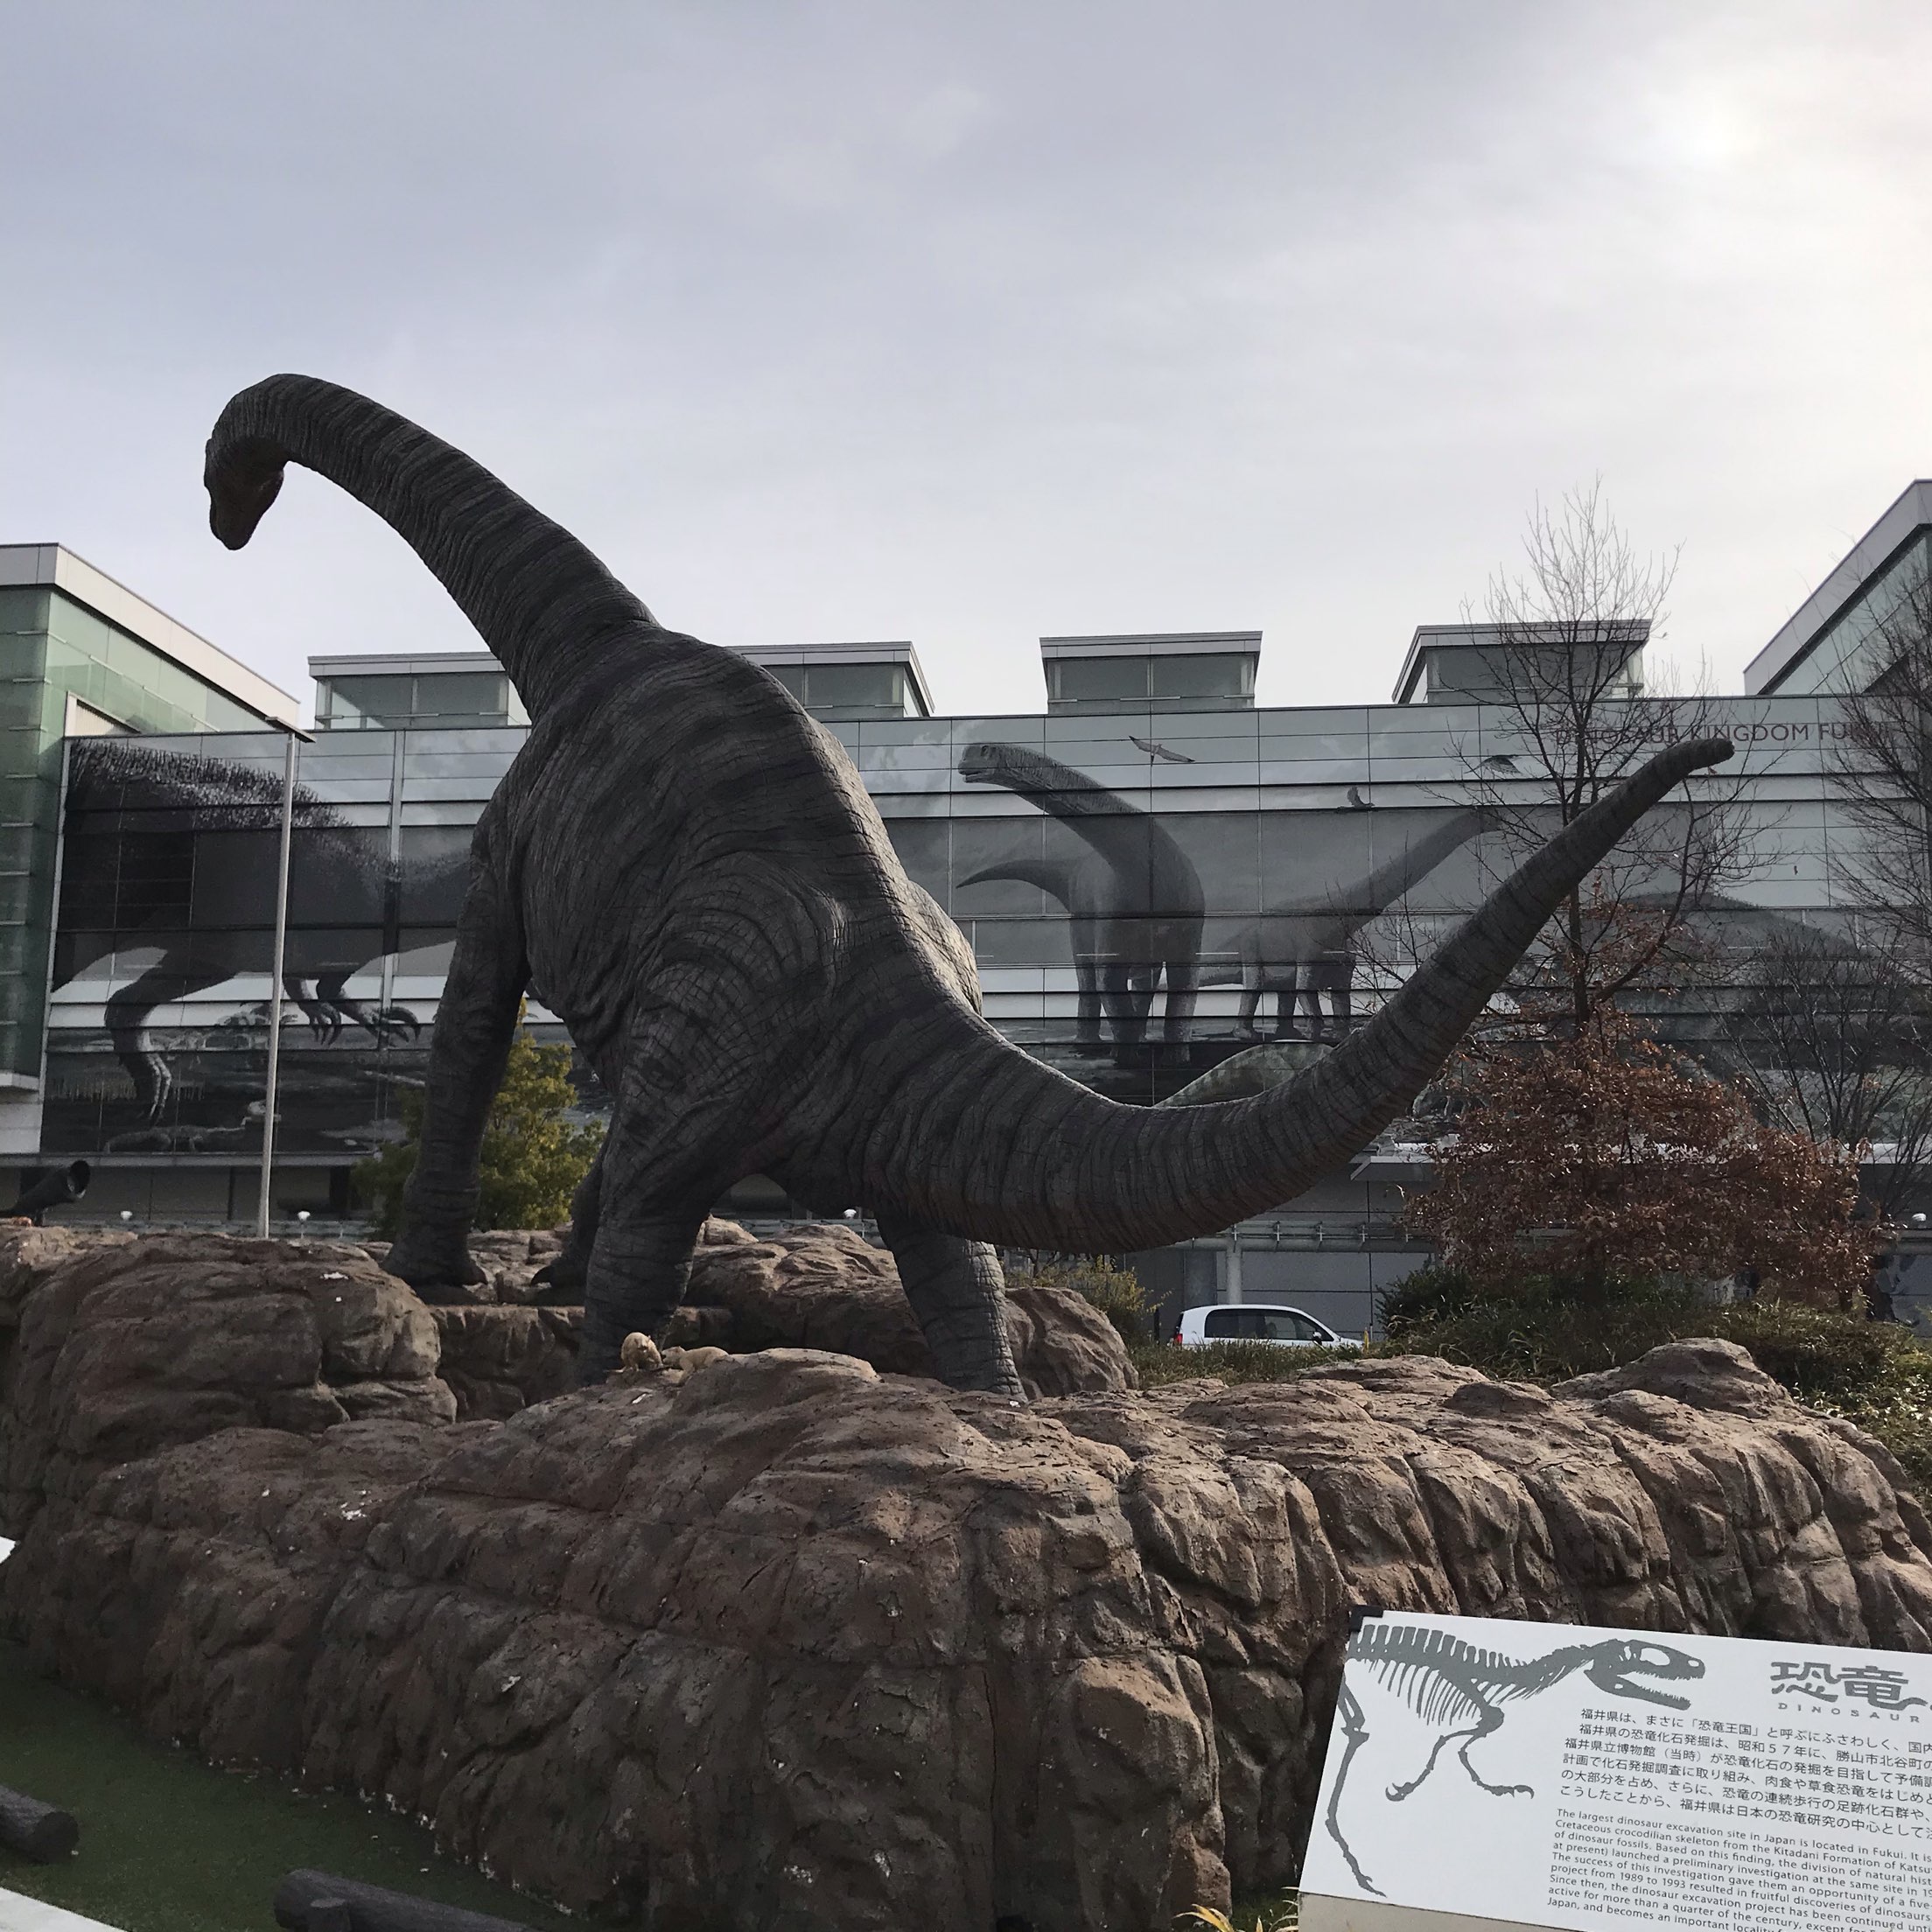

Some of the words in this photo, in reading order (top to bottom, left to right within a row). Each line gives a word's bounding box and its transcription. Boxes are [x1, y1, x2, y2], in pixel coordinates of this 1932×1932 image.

[1690, 724, 1809, 742] KINGDOM
[1770, 1662, 1932, 1711] 恐竜
[1778, 1703, 1920, 1723] DINOSAUR
[1554, 1830, 1564, 1838] of
[1567, 1831, 1613, 1844] dinosaur
[1617, 1837, 1651, 1849] fossils.
[1656, 1842, 1686, 1854] Based
[1709, 1849, 1728, 1859] this
[1732, 1852, 1774, 1867] finding,
[1778, 1858, 1796, 1868] the
[1801, 1861, 1844, 1874] division
[1849, 1867, 1861, 1876] of
[1865, 1871, 1905, 1882] natural
[1555, 1819, 1611, 1833] Cretaceous
[1614, 1828, 1671, 1840] crocodilian
[1675, 1834, 1718, 1846] skeleton
[1723, 1839, 1748, 1851] from
[1752, 1844, 1769, 1853] the
[1774, 1845, 1818, 1859] Kitadani
[1823, 1852, 1880, 1867] Formation
[1884, 1860, 1895, 1869] of
[1900, 1862, 1932, 1873] Katsu
[1557, 1808, 1575, 1817] The
[1578, 1810, 1614, 1823] largest
[1617, 1816, 1662, 1828] dinosaur
[1666, 1823, 1723, 1836] excavation
[1727, 1830, 1746, 1839] site
[1764, 1833, 1795, 1844] Japan
[1800, 1838, 1808, 1847] is
[1812, 1839, 1853, 1852] located
[1858, 1845, 1868, 1854] in
[1872, 1846, 1907, 1859] Fukui.
[1910, 1852, 1918, 1861] It
[1922, 1853, 1931, 1862] is
[1550, 1865, 1587, 1875] project
[1591, 1867, 1614, 1879] from
[1620, 1872, 1643, 1882] 1989
[1647, 1876, 1657, 1885] to
[1662, 1877, 1685, 1888] 1993
[1690, 1883, 1732, 1894] resulted
[1737, 1887, 1746, 1897] in
[1751, 1889, 1788, 1902] fruitful
[1793, 1895, 1855, 1911] discoveries
[1859, 1904, 1872, 1913] of
[1551, 1851, 1571, 1862] The
[1574, 1856, 1613, 1867] success
[1616, 1860, 1628, 1869] of
[1631, 1862, 1649, 1872] this
[1654, 1865, 1724, 1881] investigation
[1728, 1877, 1754, 1886] gave
[1758, 1879, 1787, 1890] them
[1809, 1887, 1879, 1904] opportunity
[1882, 1895, 1894, 1904] of
[1565, 1844, 1607, 1856] present)
[1612, 1847, 1659, 1862] launched
[1672, 1858, 1733, 1873] preliminary
[1738, 1864, 1808, 1881] investigation
[1827, 1876, 1845, 1886] the
[1850, 1880, 1879, 1891] same
[1883, 1884, 1902, 1894] site
[1907, 1886, 1917, 1895] in
[1547, 1896, 1579, 1909] Japan,
[1583, 1903, 1602, 1912] and
[1606, 1904, 1654, 1920] becomes
[1674, 1914, 1729, 1930] important
[1732, 1922, 1774, 1932] localit
[1548, 1886, 1579, 1897] active
[1584, 1889, 1599, 1900] for
[1602, 1894, 1630, 1904] more
[1634, 1897, 1658, 1908] than
[1672, 1904, 1713, 1915] quarter
[1717, 1908, 1729, 1918] of
[1733, 1910, 1751, 1922] the
[1755, 1915, 1802, 1929] century,
[1550, 1873, 1577, 1885] Since
[1580, 1878, 1606, 1890] then,
[1611, 1882, 1628, 1893] the
[1632, 1885, 1678, 1899] dinosaur
[1682, 1894, 1740, 1908] excavation
[1745, 1902, 1785, 1914] project
[1789, 1906, 1808, 1917] has
[1812, 1908, 1840, 1922] been
[1844, 1916, 1903, 1930] continued
